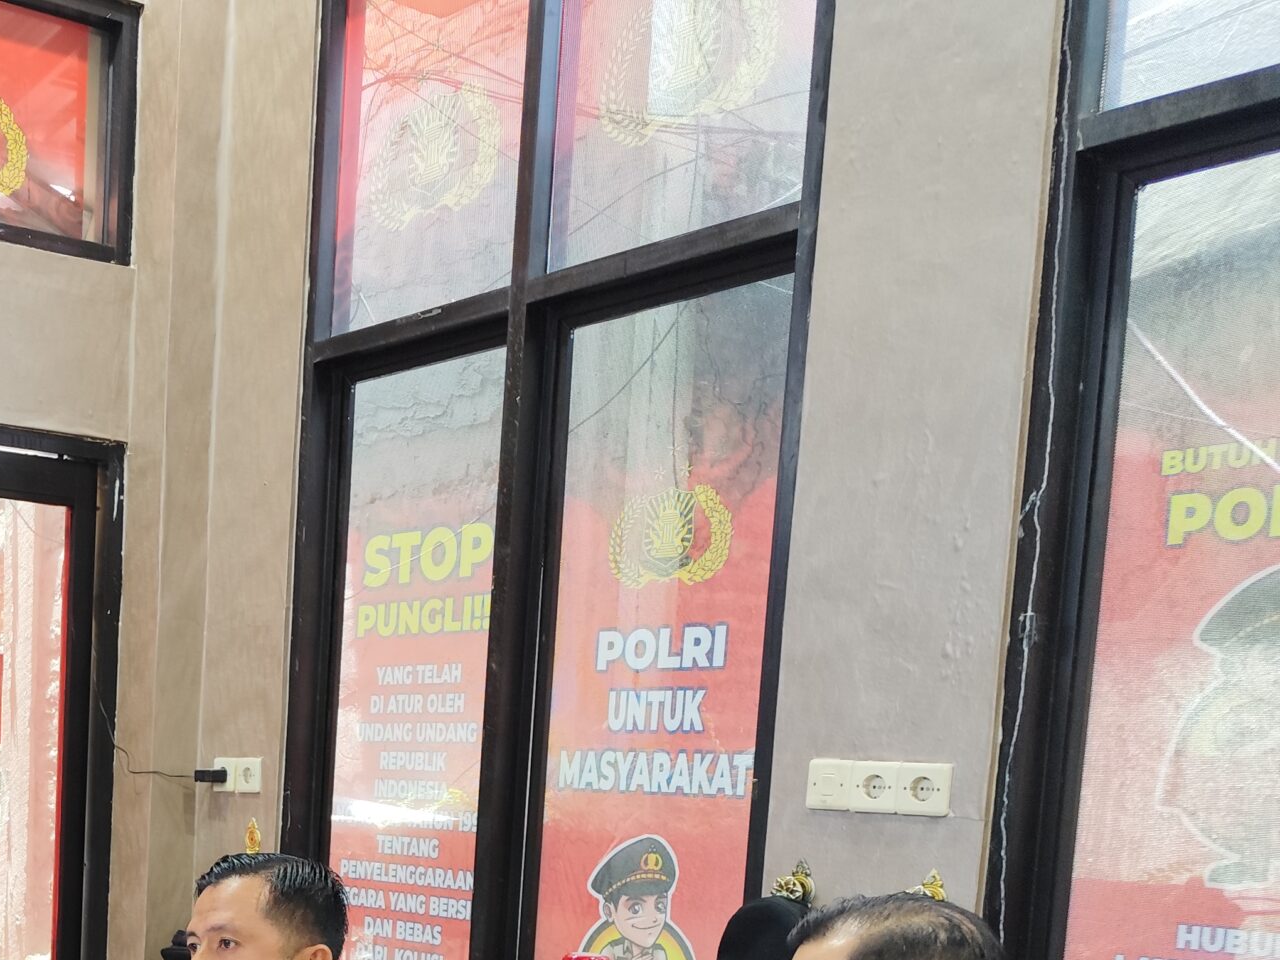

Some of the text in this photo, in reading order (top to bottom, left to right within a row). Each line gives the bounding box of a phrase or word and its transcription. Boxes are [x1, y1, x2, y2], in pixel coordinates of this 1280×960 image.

[1161, 438, 1278, 475] BUTUH
[363, 522, 495, 588] STOP
[356, 594, 491, 639] PUNGLI!!
[595, 624, 729, 671] POLRI
[376, 664, 462, 686] YANG TELAH
[370, 693, 465, 714] DI ATUR OLEH
[607, 689, 707, 732] UNTUK
[357, 722, 478, 743] UNDANG UNDANG
[379, 751, 448, 772] REPUBLIK
[558, 750, 756, 797] MASYARAKAT
[375, 778, 450, 800] INDONESIA
[376, 834, 440, 859] TENTANG
[340, 858, 474, 891] PENYELENGGARAAN
[344, 886, 386, 910] EGARA
[389, 891, 426, 914] YANG
[363, 916, 442, 945] DAN BEBAS
[1176, 924, 1280, 959] HUBU
